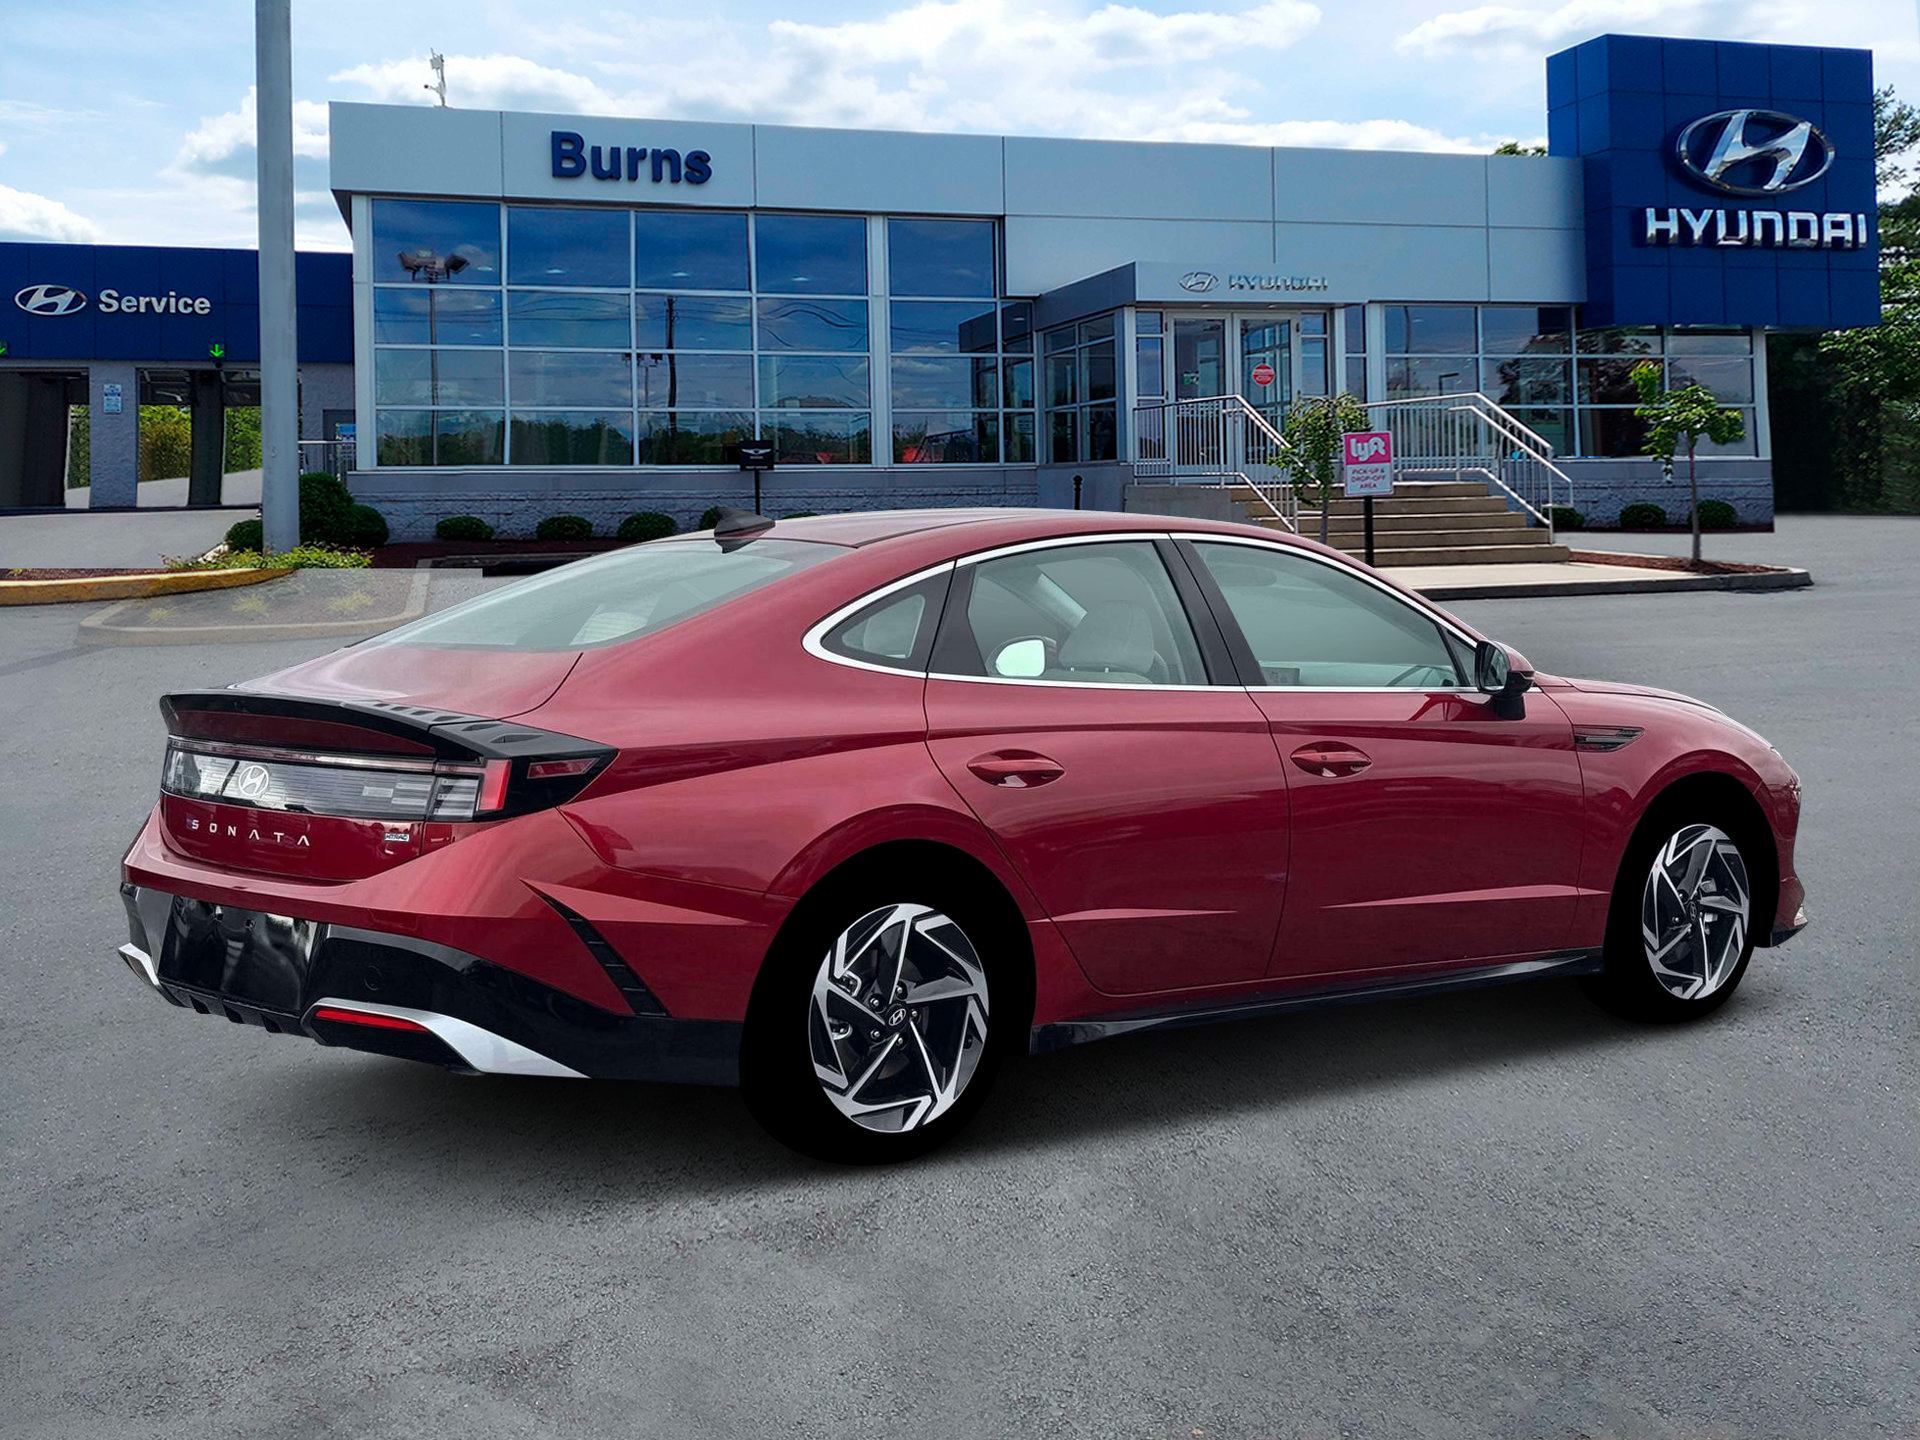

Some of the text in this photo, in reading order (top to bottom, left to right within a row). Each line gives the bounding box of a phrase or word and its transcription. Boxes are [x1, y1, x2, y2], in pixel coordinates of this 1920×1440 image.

[551, 131, 712, 184] Burns
[1645, 207, 1867, 249] HYUNDAI
[1228, 274, 1328, 291] HYUNDAI
[98, 289, 211, 315] Service
[191, 819, 310, 847] SONATA
